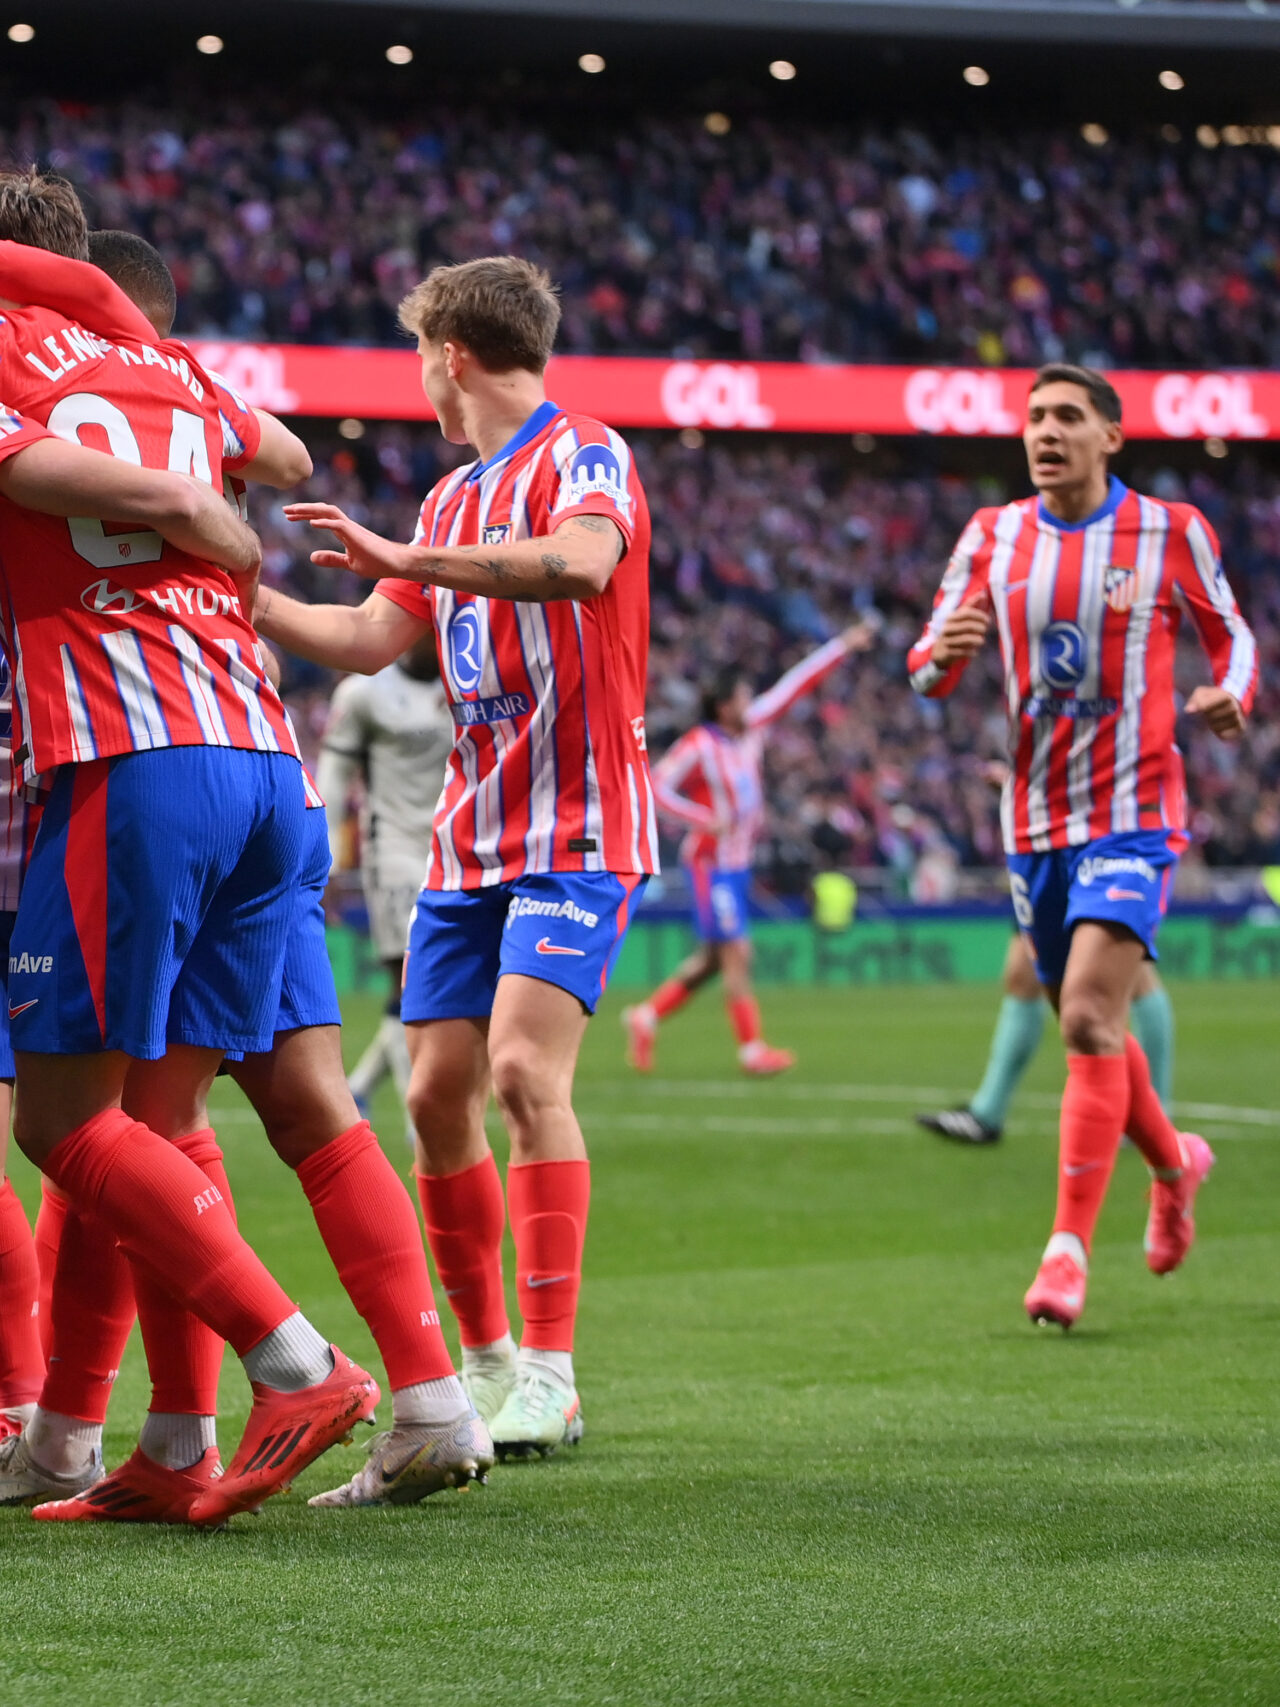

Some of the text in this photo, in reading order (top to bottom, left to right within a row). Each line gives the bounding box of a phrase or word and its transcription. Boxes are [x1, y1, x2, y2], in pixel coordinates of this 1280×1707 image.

[660, 361, 775, 428] GOL
[903, 369, 1019, 434] GOL
[1151, 373, 1269, 438] GOL
[492, 694, 526, 719] AIR
[517, 897, 599, 928] ComAve
